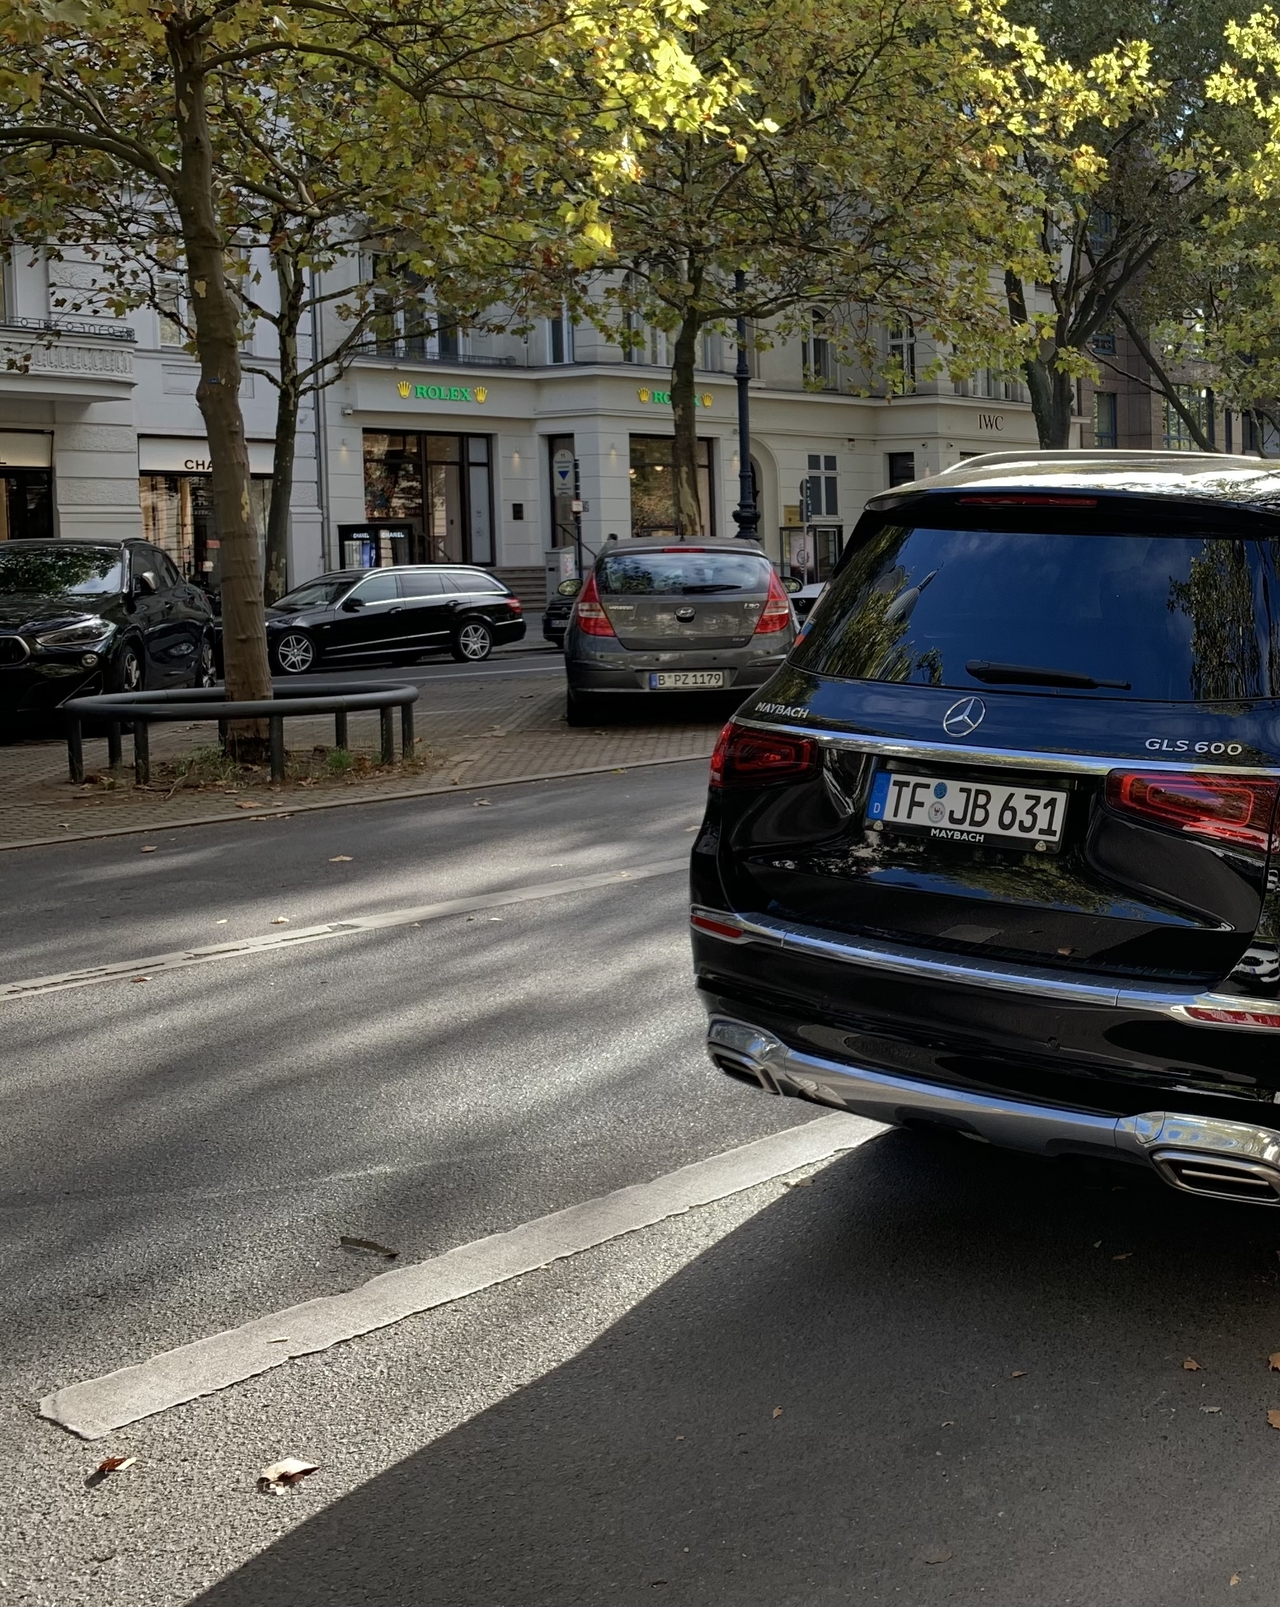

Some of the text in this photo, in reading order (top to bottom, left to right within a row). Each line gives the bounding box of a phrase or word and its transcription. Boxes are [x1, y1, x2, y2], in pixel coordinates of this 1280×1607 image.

[415, 385, 472, 402] ROLEX
[653, 390, 701, 407] ROX
[978, 413, 1004, 431] IWC
[184, 459, 213, 470] CHA
[658, 673, 721, 686] B PZ 1179
[755, 702, 810, 719] MAYBACH
[1145, 738, 1243, 756] GLS 600
[873, 779, 1058, 838] D TF JB 631
[930, 828, 985, 843] MAYBACH
